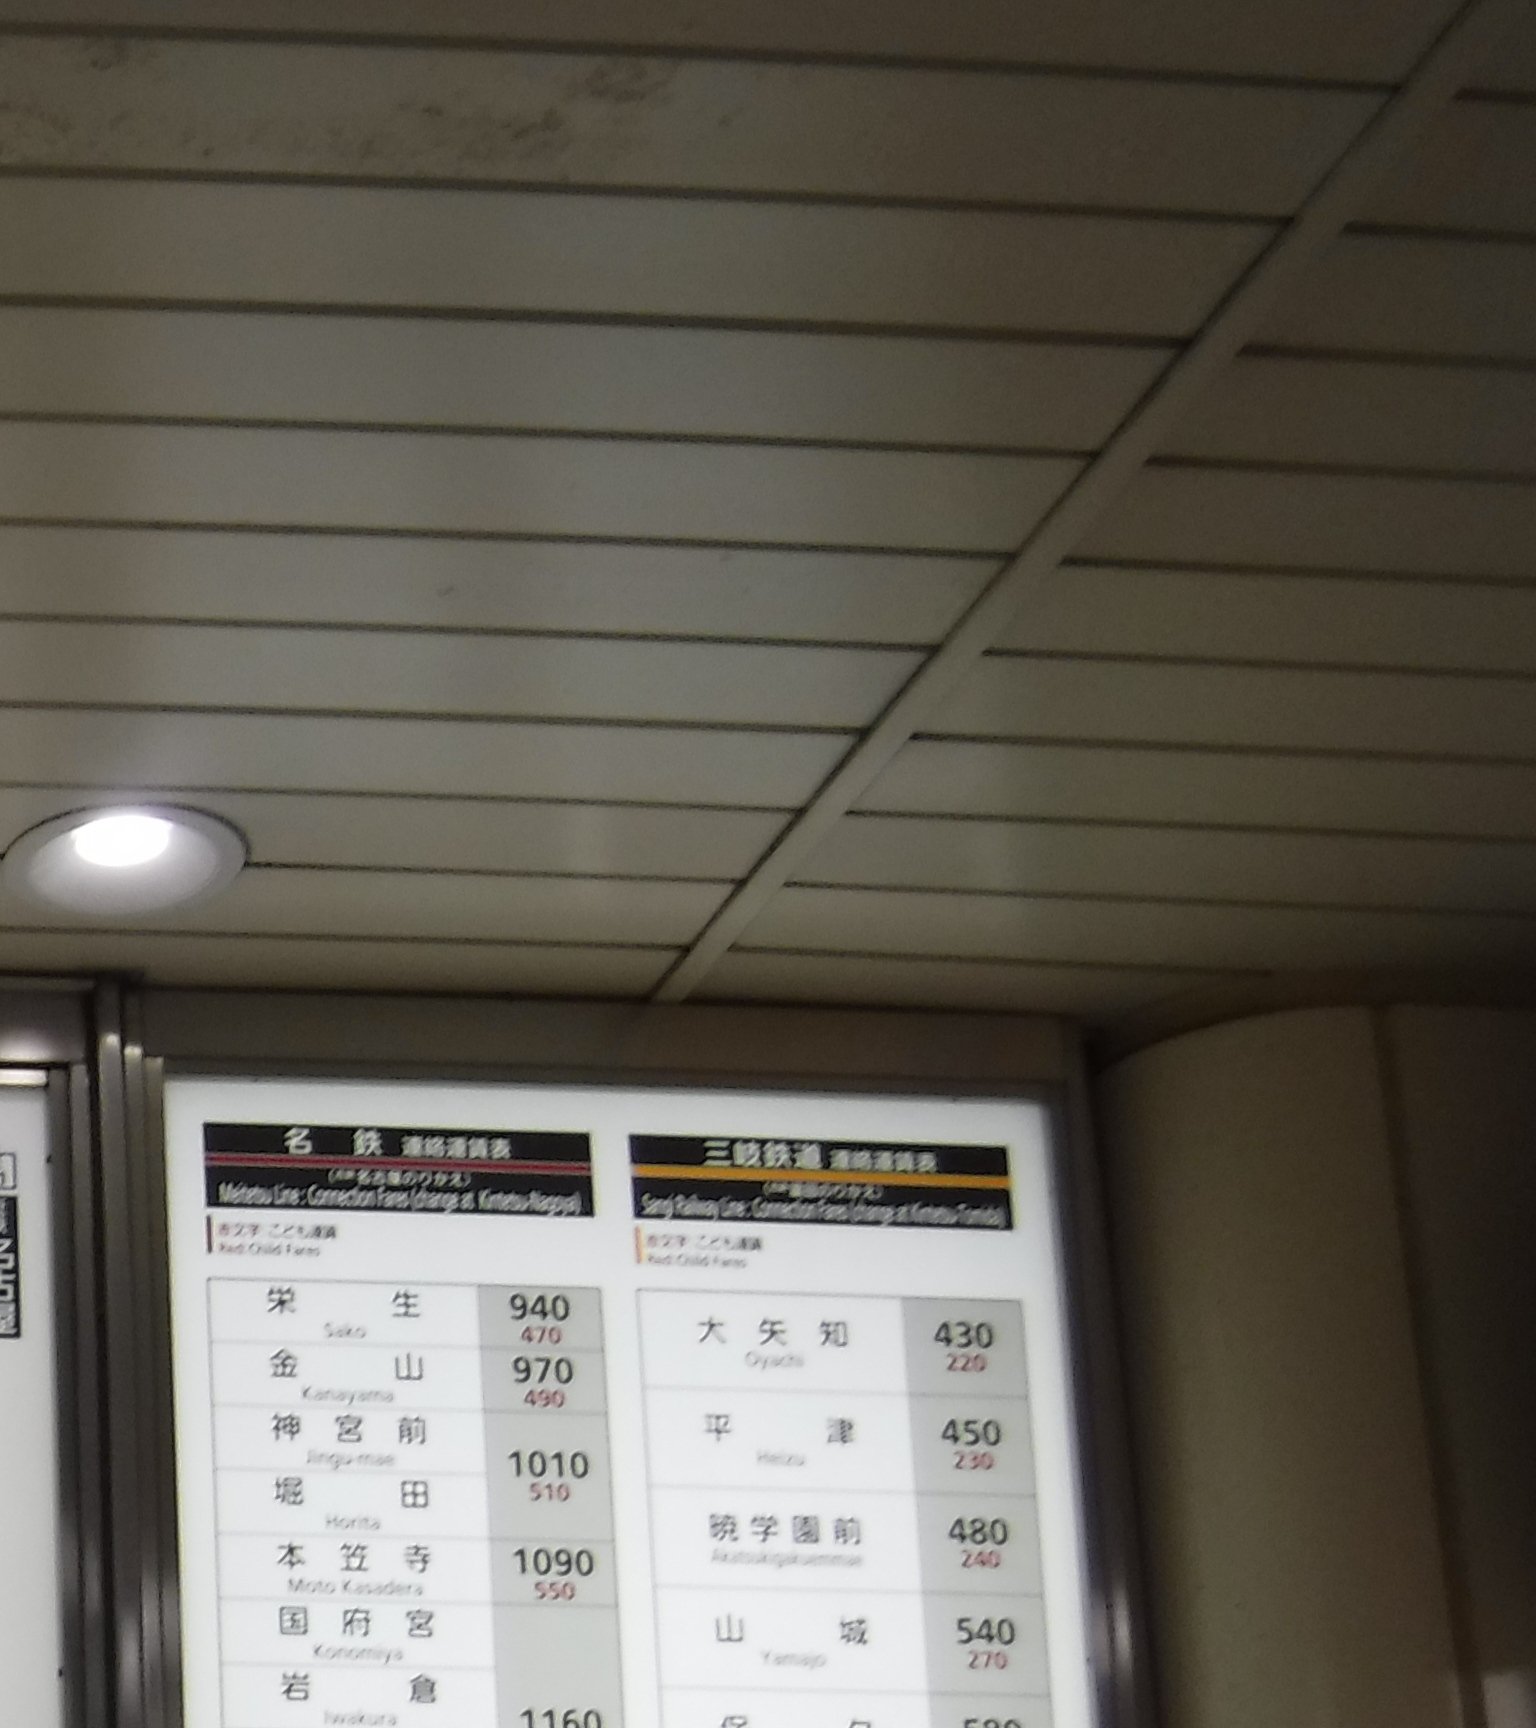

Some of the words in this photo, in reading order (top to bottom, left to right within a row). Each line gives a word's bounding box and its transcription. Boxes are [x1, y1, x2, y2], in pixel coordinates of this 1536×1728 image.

[283, 1128, 383, 1155] 名鉄
[266, 1287, 422, 1318] 栄生
[510, 1293, 570, 1322] 940
[521, 1326, 561, 1345] 470
[699, 1316, 849, 1346] 大矢知
[934, 1321, 994, 1349] 430
[270, 1350, 424, 1380] 金山
[513, 1356, 573, 1385] 970
[524, 1389, 565, 1408] 490
[272, 1414, 427, 1446] 神宮前
[705, 1414, 855, 1444] 平津
[941, 1419, 1001, 1447] 450
[508, 1449, 588, 1480] 1010
[275, 1477, 429, 1509] 堀田
[530, 1483, 570, 1502] 510
[949, 1517, 1008, 1545] 480
[277, 1543, 430, 1573] 本笠寺
[513, 1547, 594, 1576] 1090
[534, 1581, 575, 1601] 550
[279, 1607, 434, 1637] 国府宮
[716, 1615, 870, 1646] 山城
[957, 1618, 1016, 1647] 540
[969, 1650, 1008, 1669] 270
[282, 1673, 437, 1703] 岩倉
